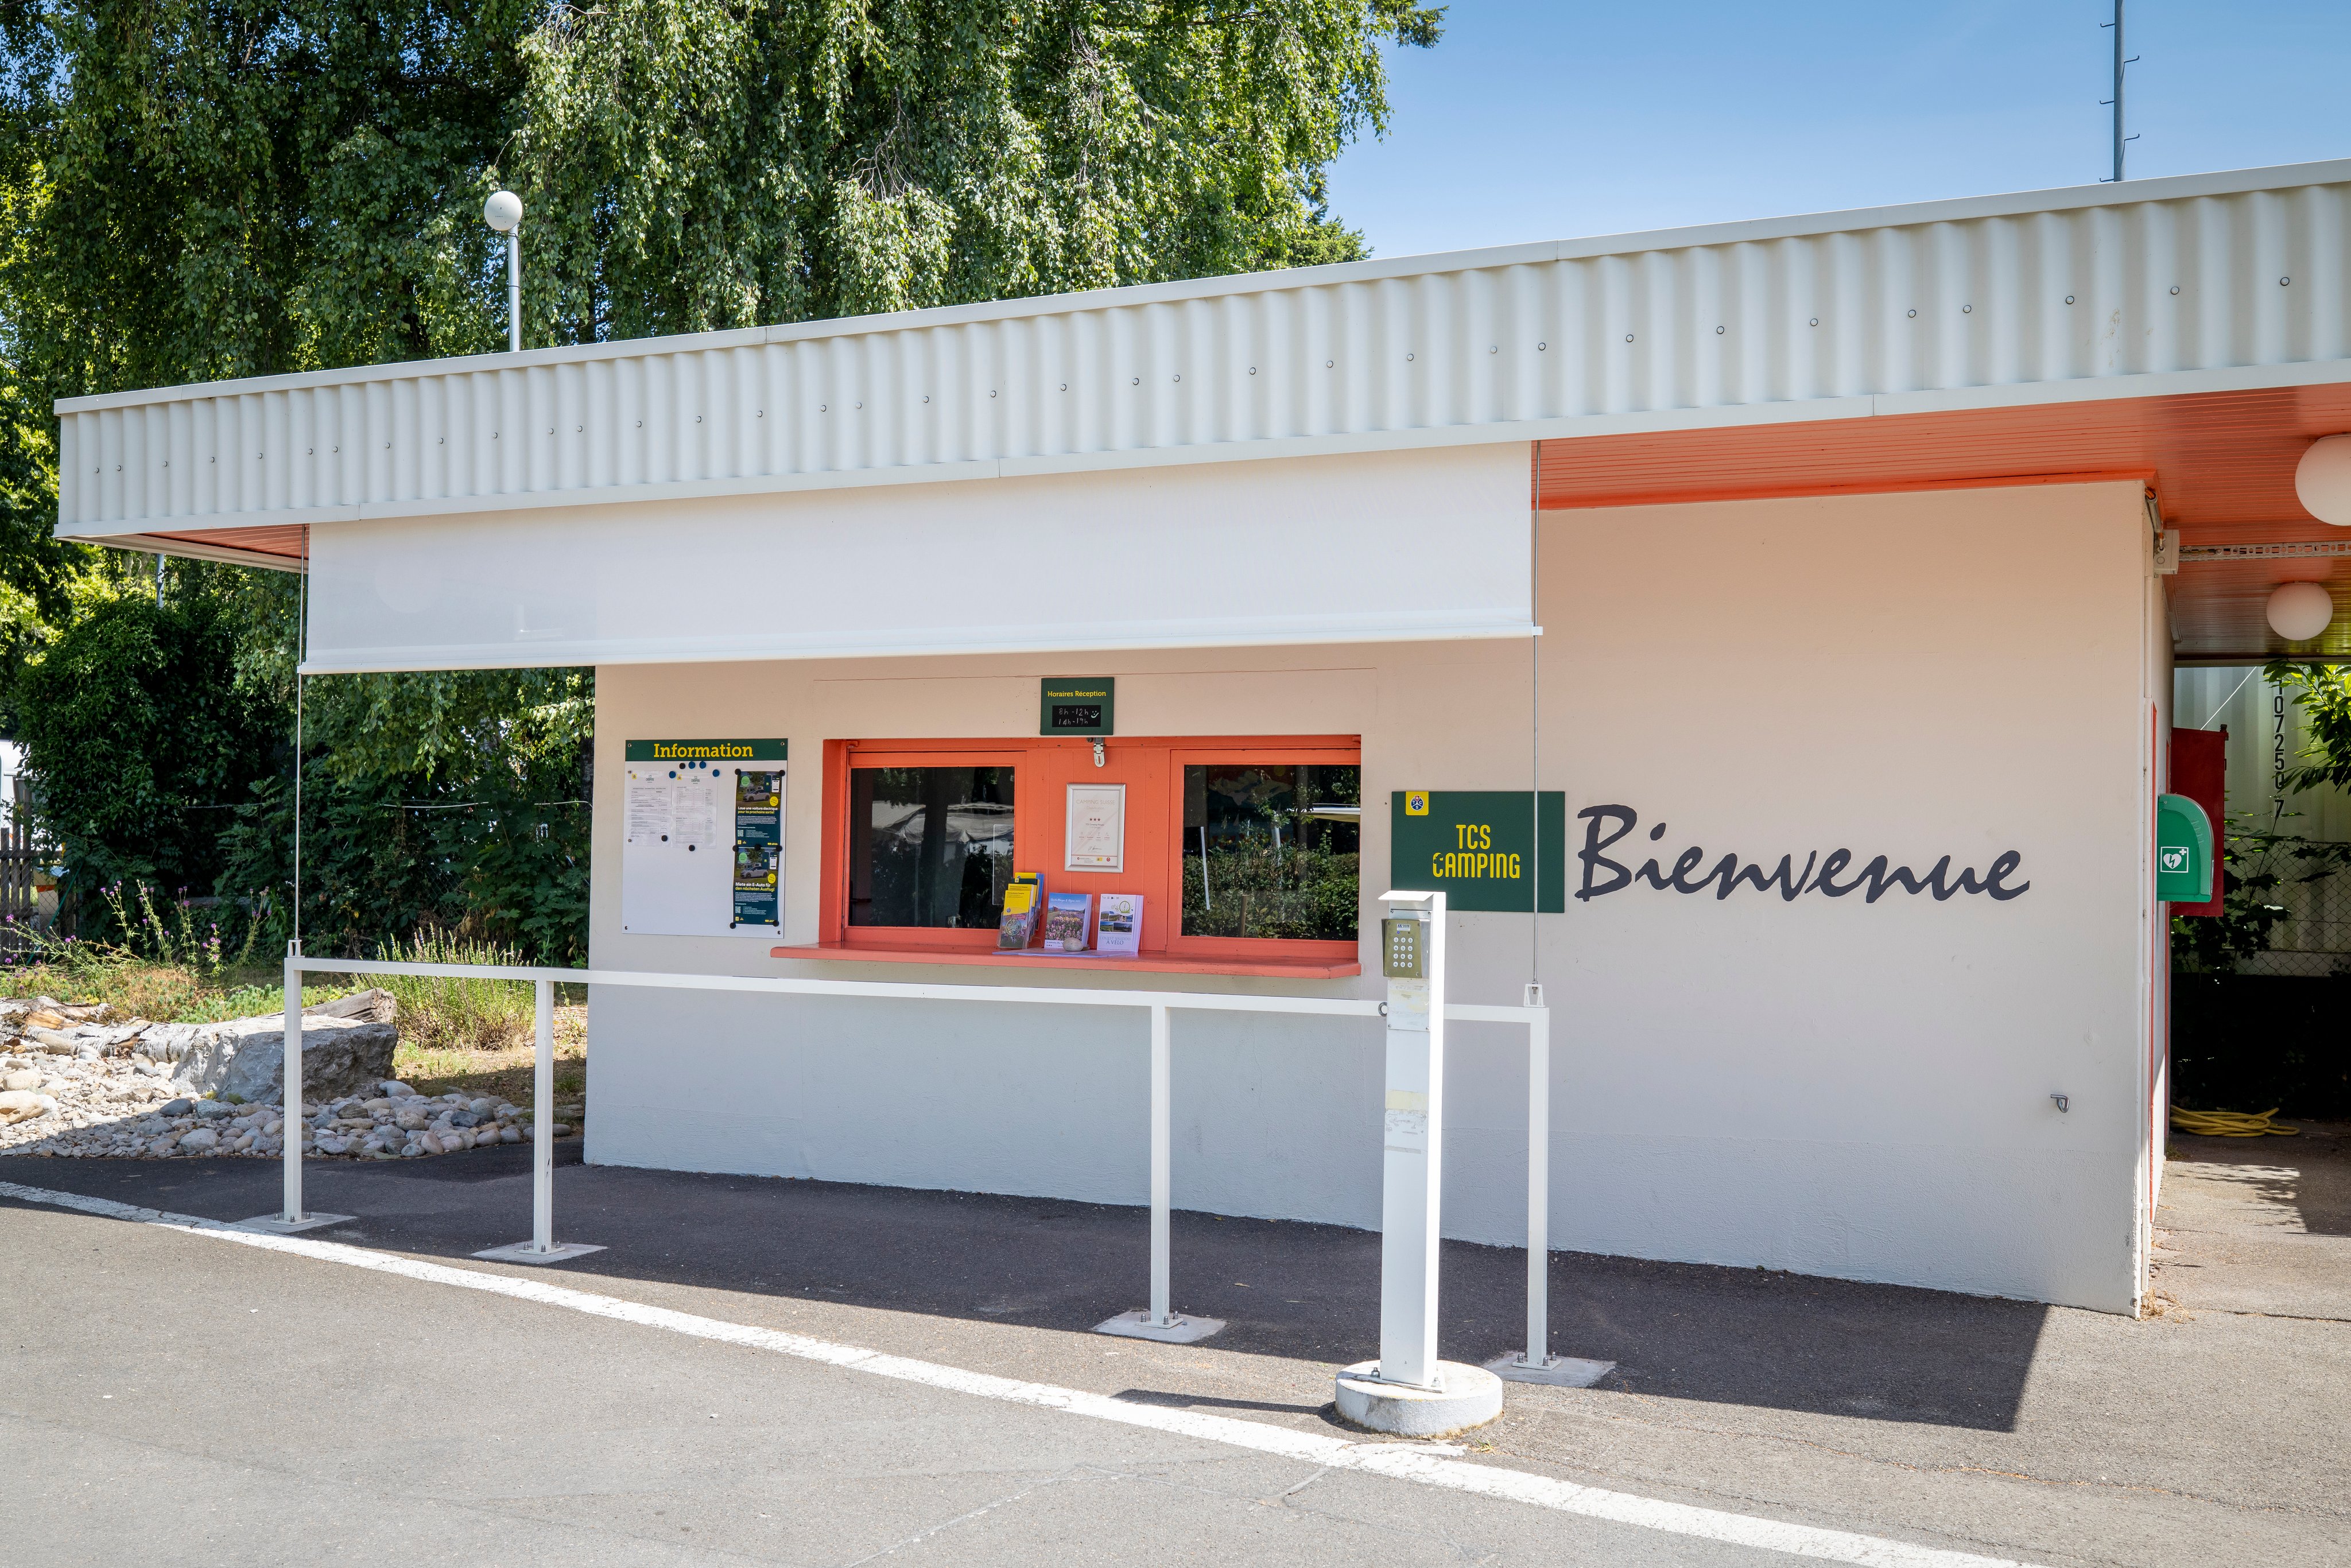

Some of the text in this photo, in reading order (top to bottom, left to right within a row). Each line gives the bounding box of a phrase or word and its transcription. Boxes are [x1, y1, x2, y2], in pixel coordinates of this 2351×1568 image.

[1074, 690, 1107, 698] Réception
[654, 743, 754, 758] Information
[1456, 824, 1491, 849] TCS
[1433, 852, 1520, 879] CAMPING
[1574, 804, 2030, 903] Bienvenue
